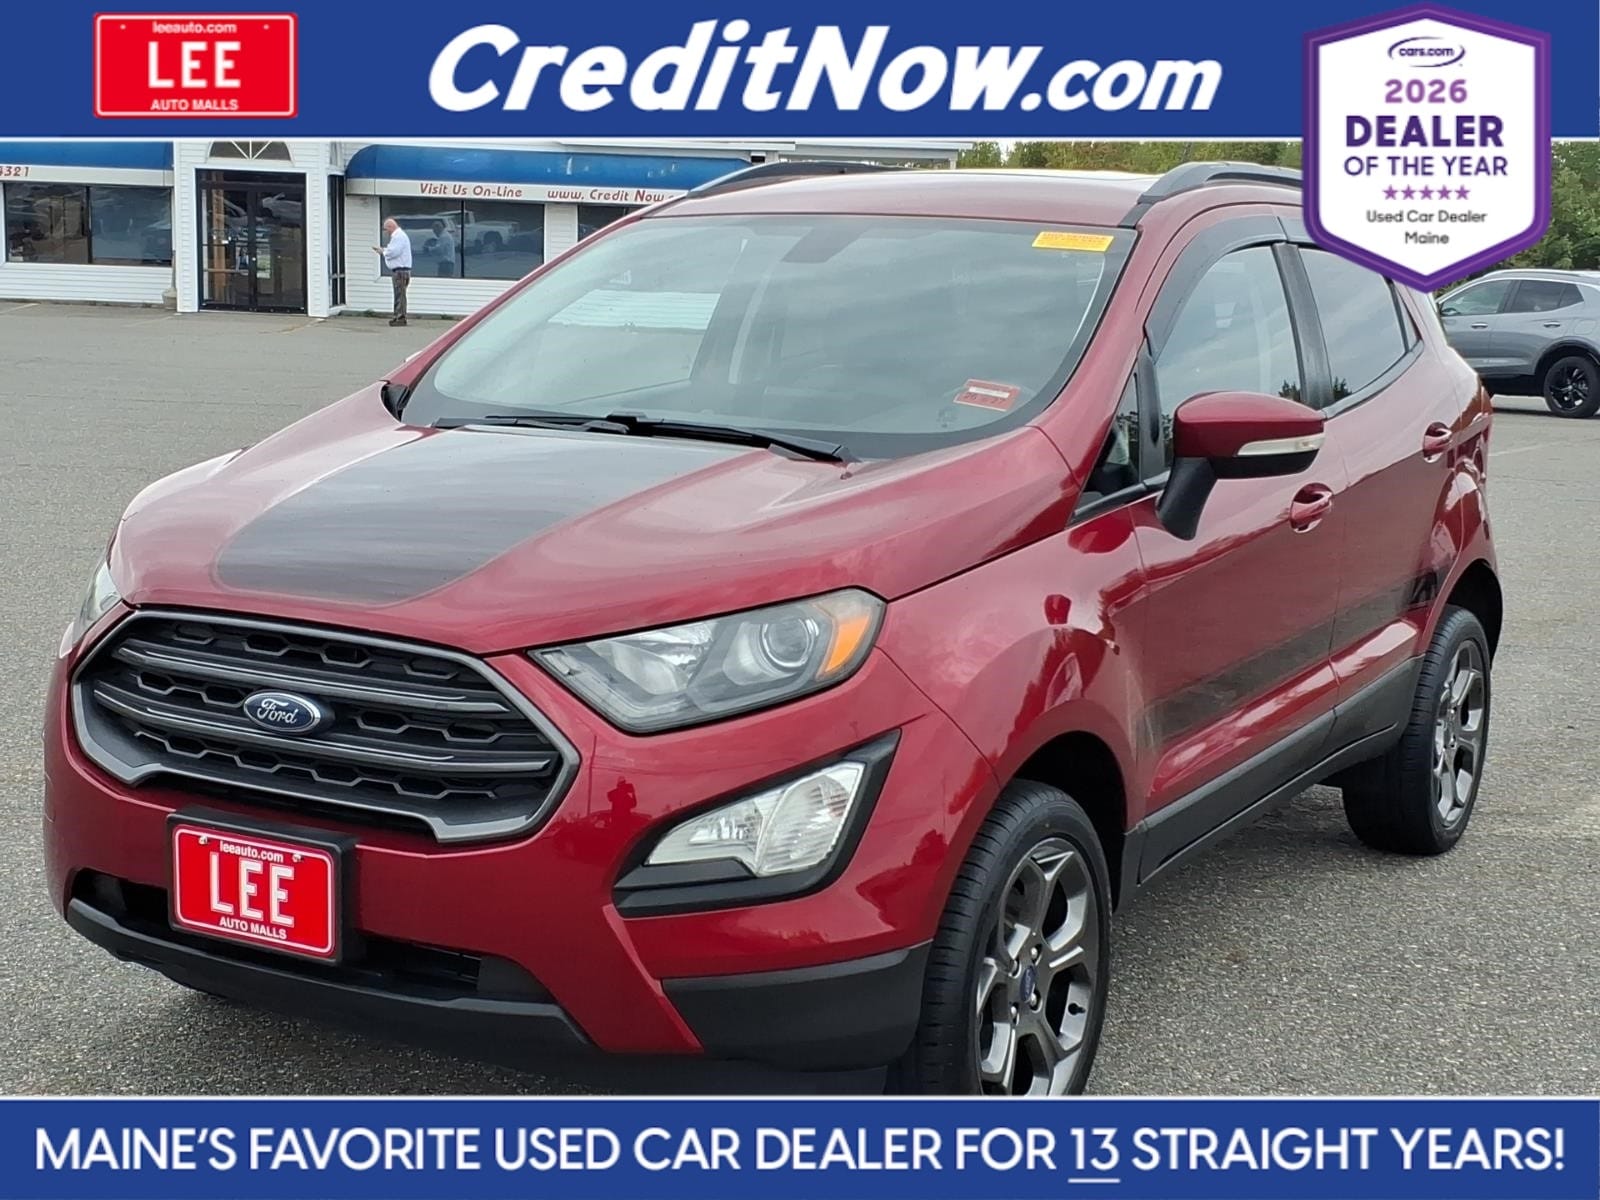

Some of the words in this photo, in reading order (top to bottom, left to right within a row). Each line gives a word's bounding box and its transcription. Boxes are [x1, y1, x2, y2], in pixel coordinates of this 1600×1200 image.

[420, 183, 448, 195] Visit
[452, 184, 467, 196] Us
[473, 185, 522, 198] On-Line
[590, 189, 629, 201] Credit
[634, 190, 664, 202] Now
[256, 698, 298, 724] Ford
[219, 840, 284, 863] leeauto.com
[209, 851, 295, 928] LEE
[218, 916, 249, 933] AUTO
[250, 923, 287, 940] MALLS
